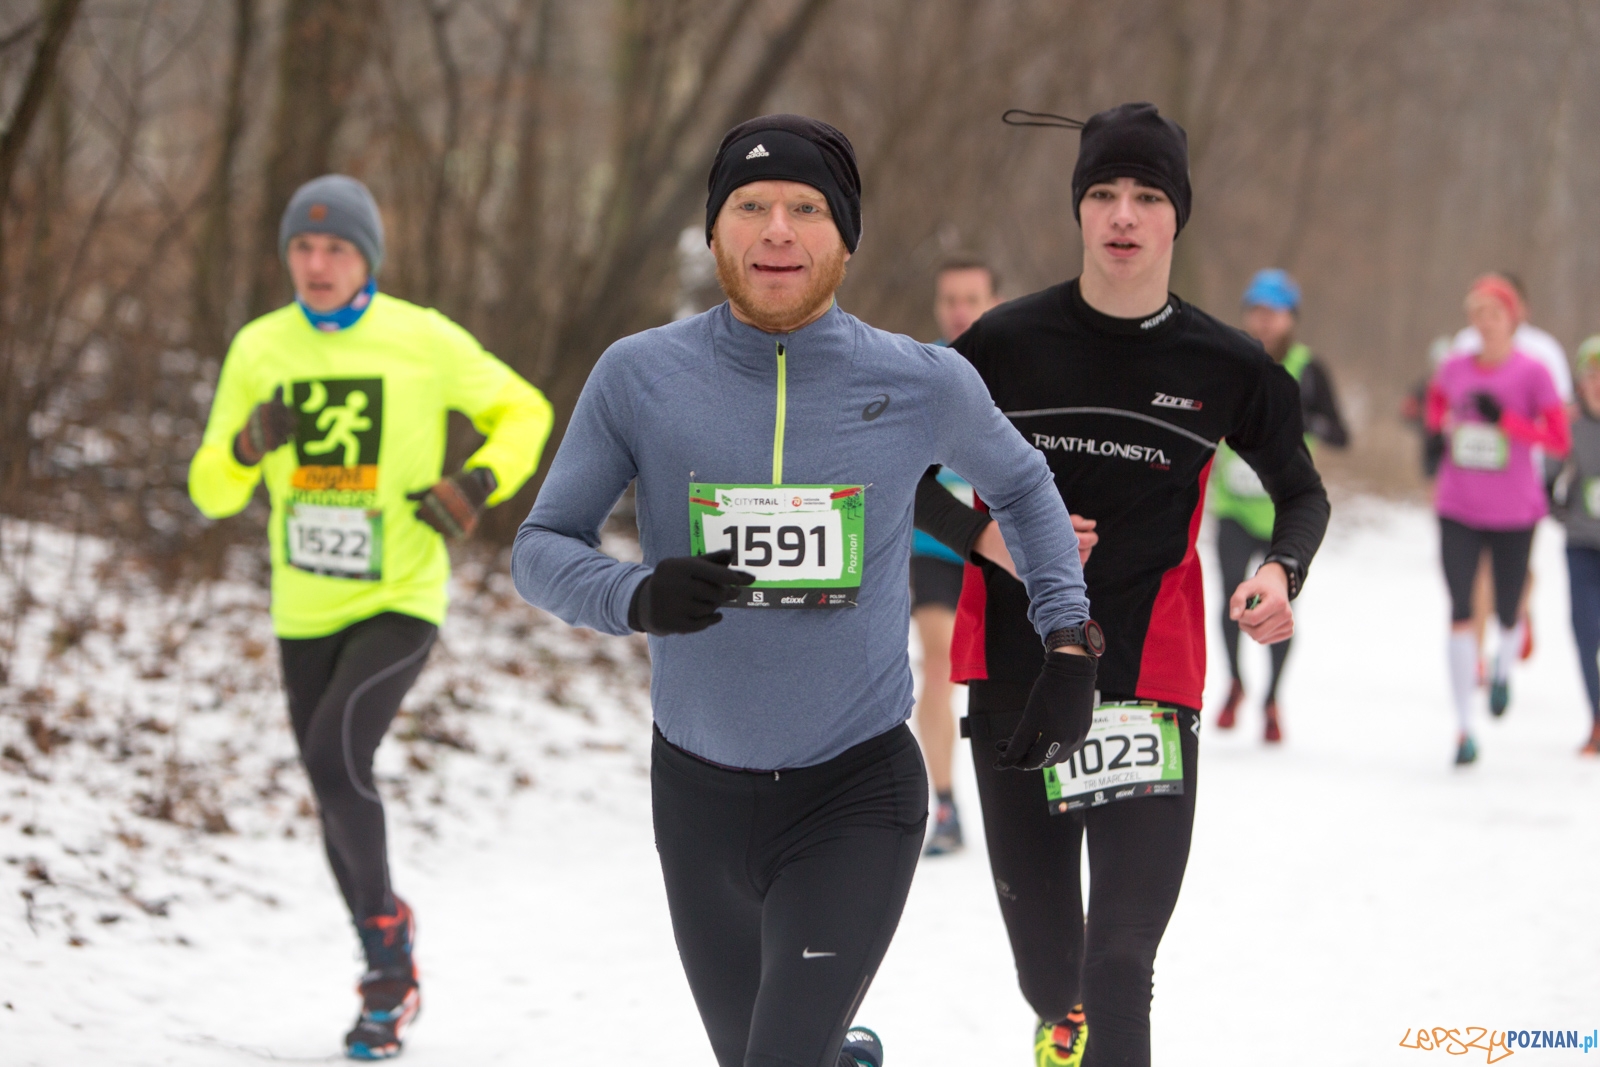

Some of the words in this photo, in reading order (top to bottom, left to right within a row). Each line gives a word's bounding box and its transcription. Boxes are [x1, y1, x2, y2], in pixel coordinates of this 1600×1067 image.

[1032, 433, 1167, 465] TRIATHLONISTA
[296, 526, 367, 557] 1522
[723, 525, 826, 567] 1591
[848, 533, 858, 574] Poznań
[1068, 733, 1160, 779] 1023
[1098, 771, 1142, 787] MARCZEL
